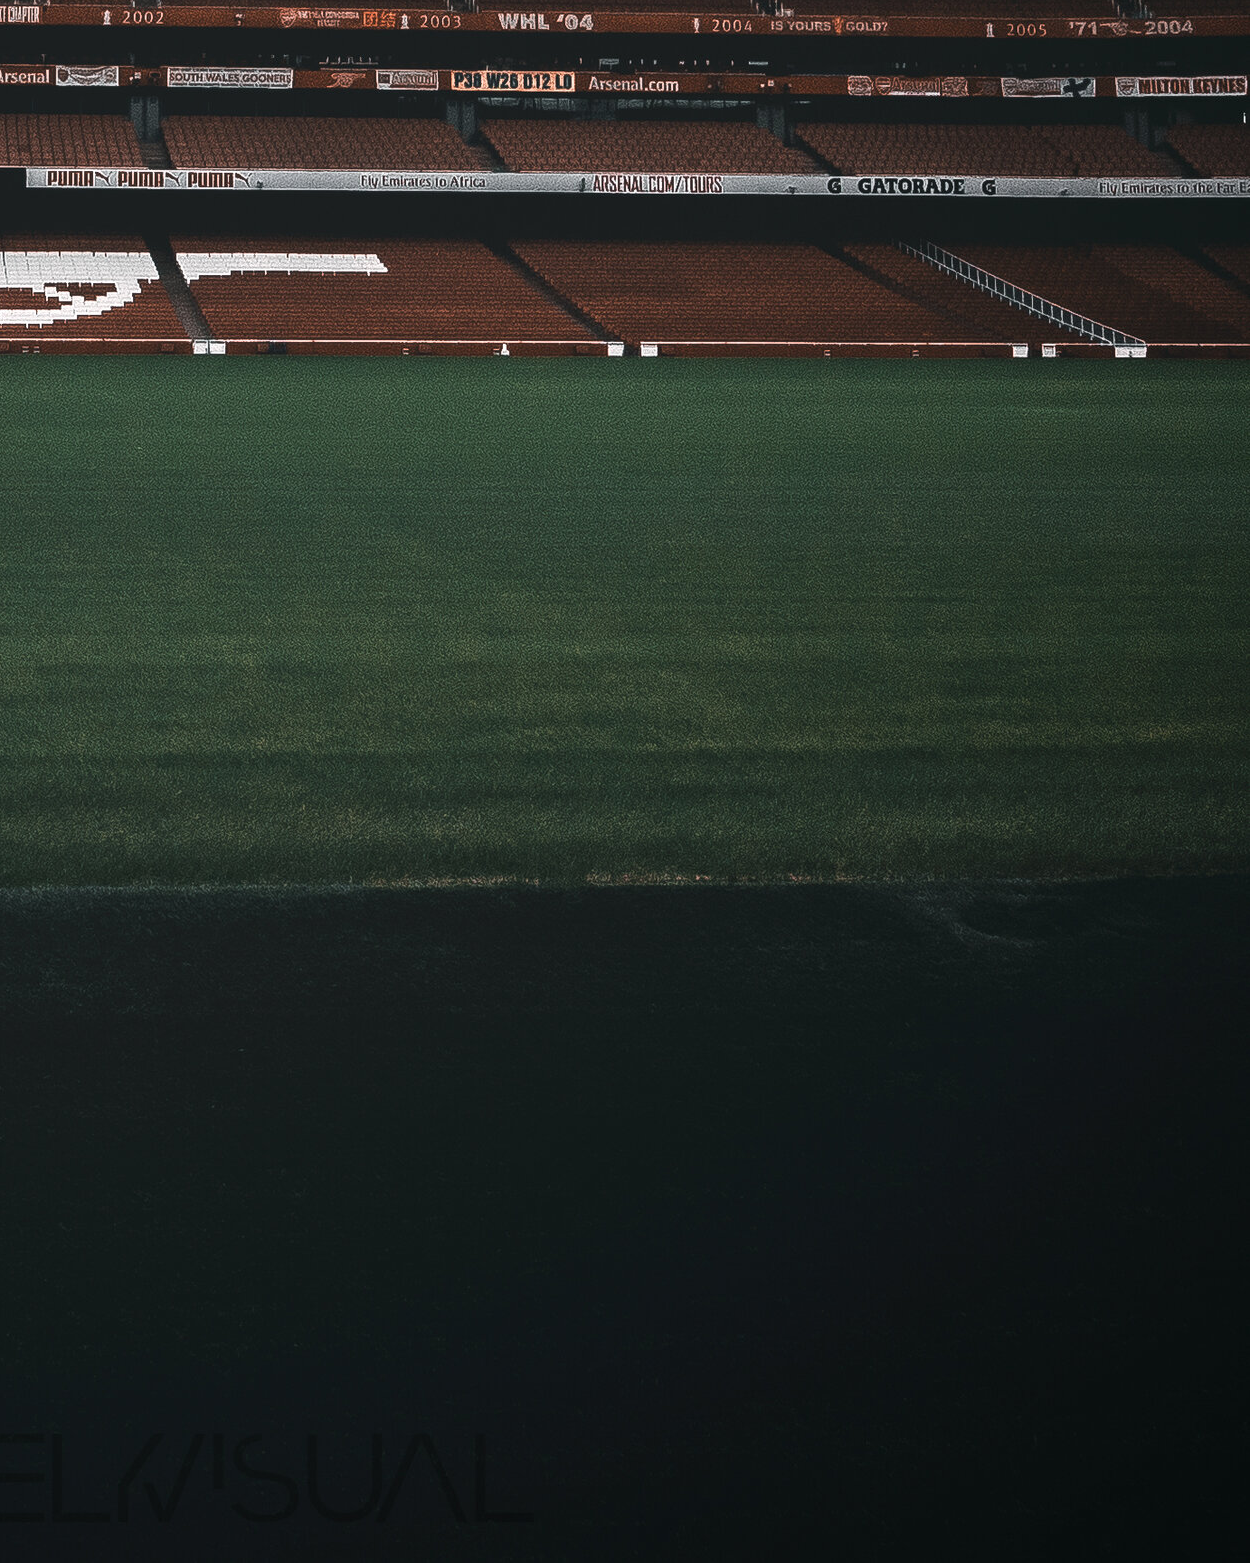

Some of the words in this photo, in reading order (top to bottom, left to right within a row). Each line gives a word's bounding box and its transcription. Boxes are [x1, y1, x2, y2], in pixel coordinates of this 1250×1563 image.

[122, 10, 165, 24] 2002
[419, 14, 462, 29] 2003
[498, 13, 550, 30] WHL
[712, 19, 752, 33] 2004
[771, 21, 784, 31] IS
[786, 21, 832, 32] YOURS
[845, 21, 888, 32] GOLD?
[1006, 23, 1047, 37] 2005
[1144, 20, 1194, 35] 2004
[170, 72, 205, 82] SOUTH
[206, 72, 240, 83] WALES
[243, 73, 291, 84] GOONERS
[454, 72, 482, 88] P38
[486, 72, 518, 88] W26
[524, 72, 551, 89] D12
[588, 76, 679, 92] Arsenal.com
[1139, 79, 1190, 94] MILTON
[1193, 78, 1245, 94] KEYNES
[47, 170, 94, 186] PUMA
[117, 171, 165, 187] PUMA
[188, 172, 234, 187] PUMA
[361, 175, 378, 188] Fly
[382, 175, 432, 188] Emirates
[435, 176, 447, 188] to
[450, 175, 486, 188] Africa
[593, 175, 723, 193] ARSENAL.COM/TOURS
[857, 178, 965, 194] GATORADE
[1100, 182, 1117, 195] Fly
[1121, 182, 1173, 194] Emirates
[1177, 184, 1189, 194] to
[1192, 182, 1213, 194] the
[1217, 183, 1236, 194] Far
